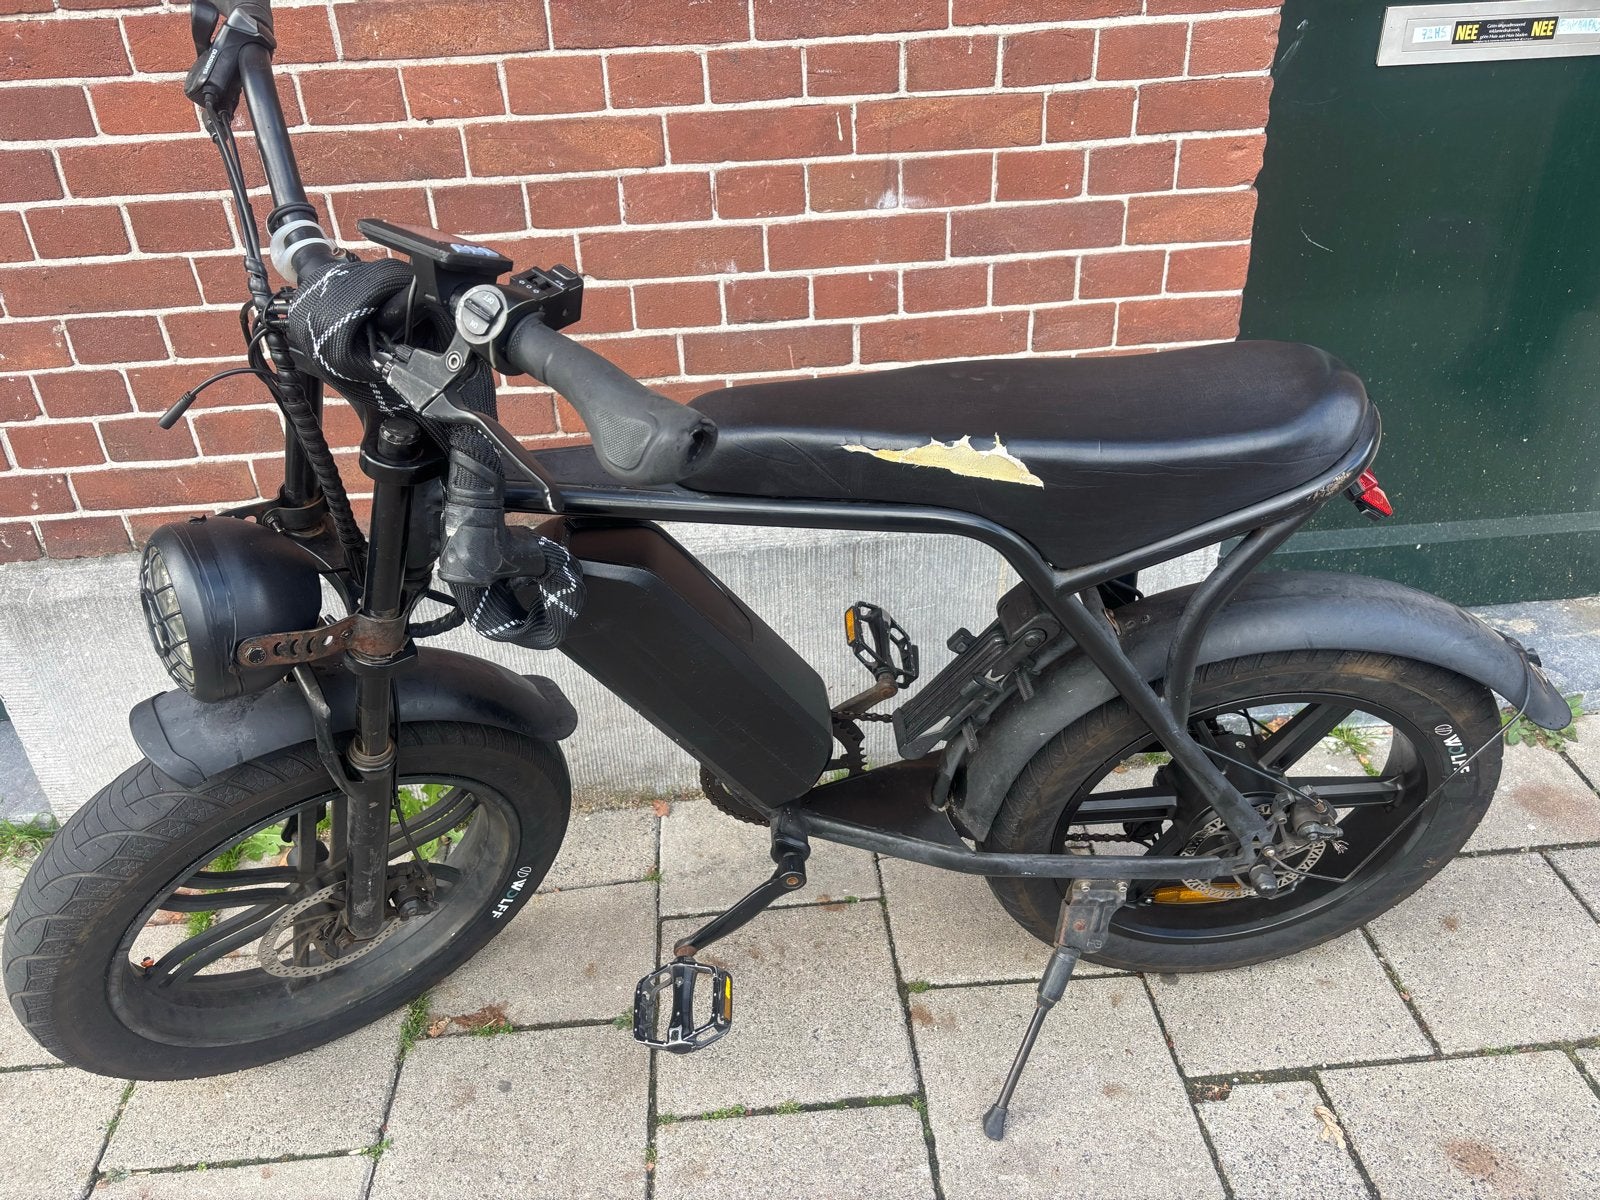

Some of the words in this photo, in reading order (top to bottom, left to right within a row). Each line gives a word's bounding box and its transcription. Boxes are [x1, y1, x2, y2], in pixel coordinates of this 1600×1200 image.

[1455, 24, 1480, 41] NEE
[1530, 20, 1556, 36] NEE
[491, 878, 528, 919] WOLFF
